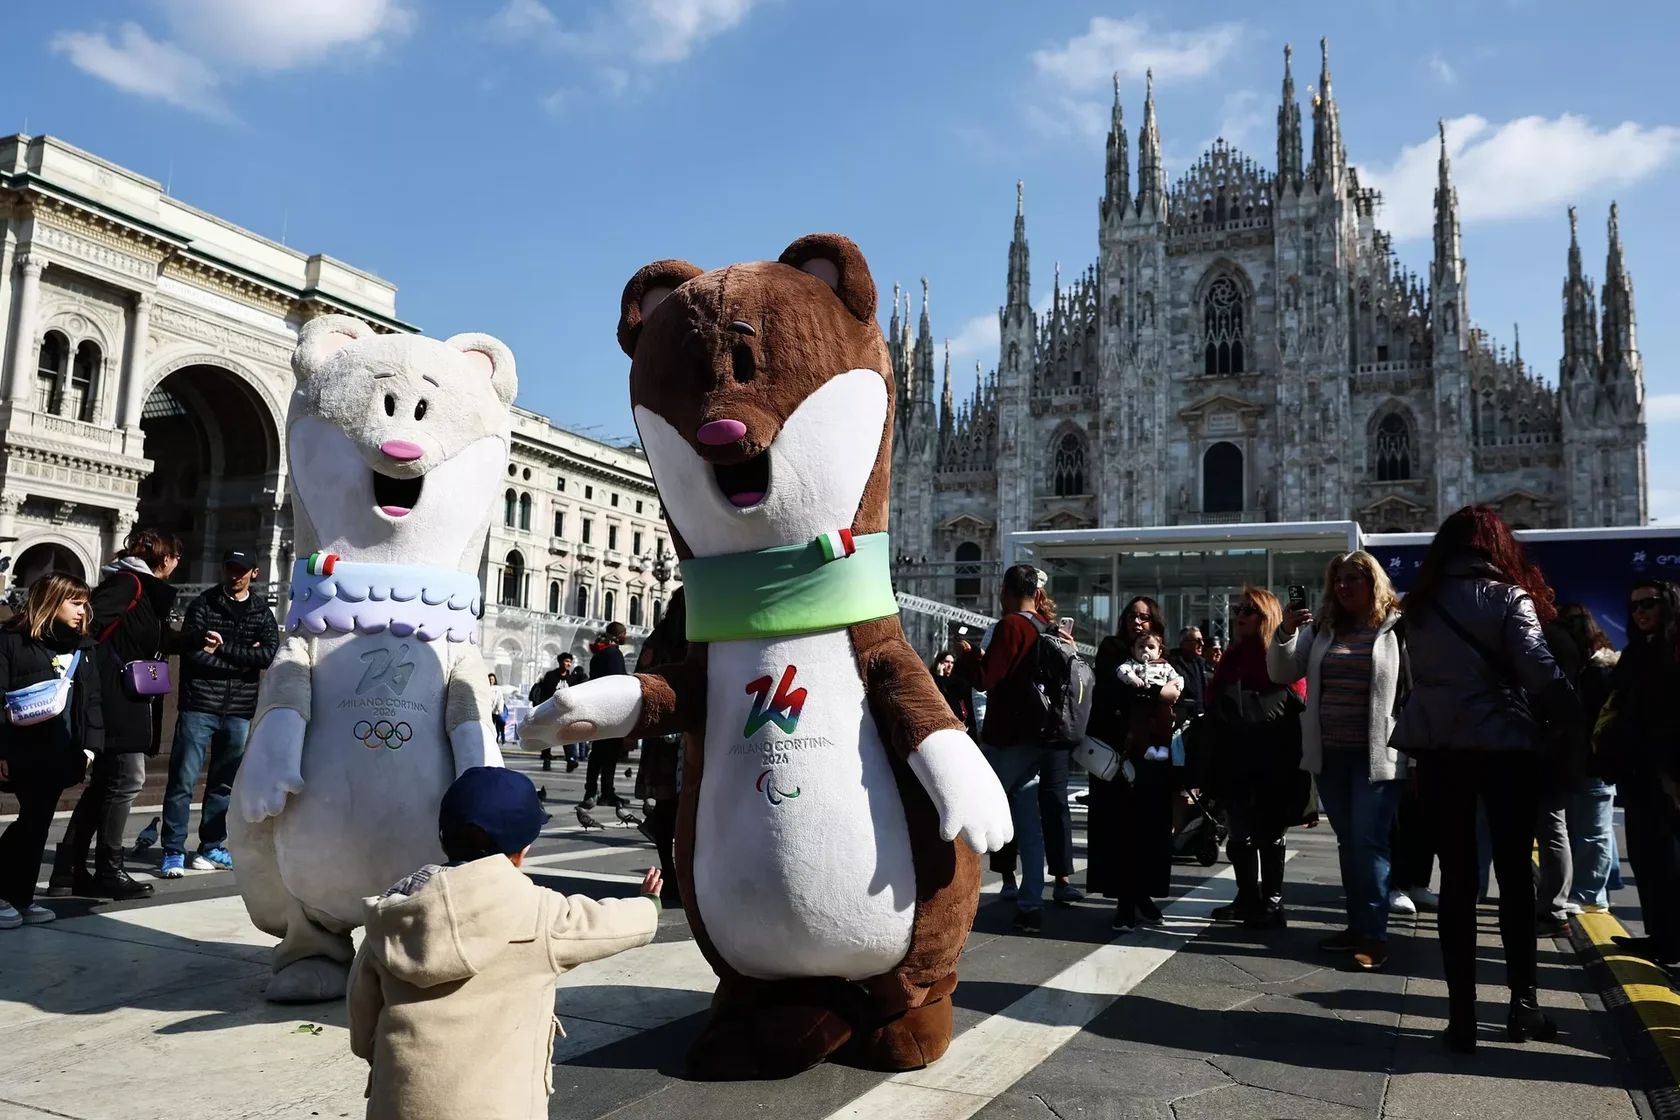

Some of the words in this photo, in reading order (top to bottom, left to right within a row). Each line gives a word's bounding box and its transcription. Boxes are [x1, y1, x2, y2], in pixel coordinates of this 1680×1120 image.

[336, 697, 383, 709] MILANO
[385, 698, 428, 712] CORTINA
[372, 707, 396, 717] 2026
[18, 705, 57, 721] BAGGAGE
[727, 742, 773, 755] MILANO
[774, 737, 834, 752] CORTINA
[762, 753, 789, 766] 2026
